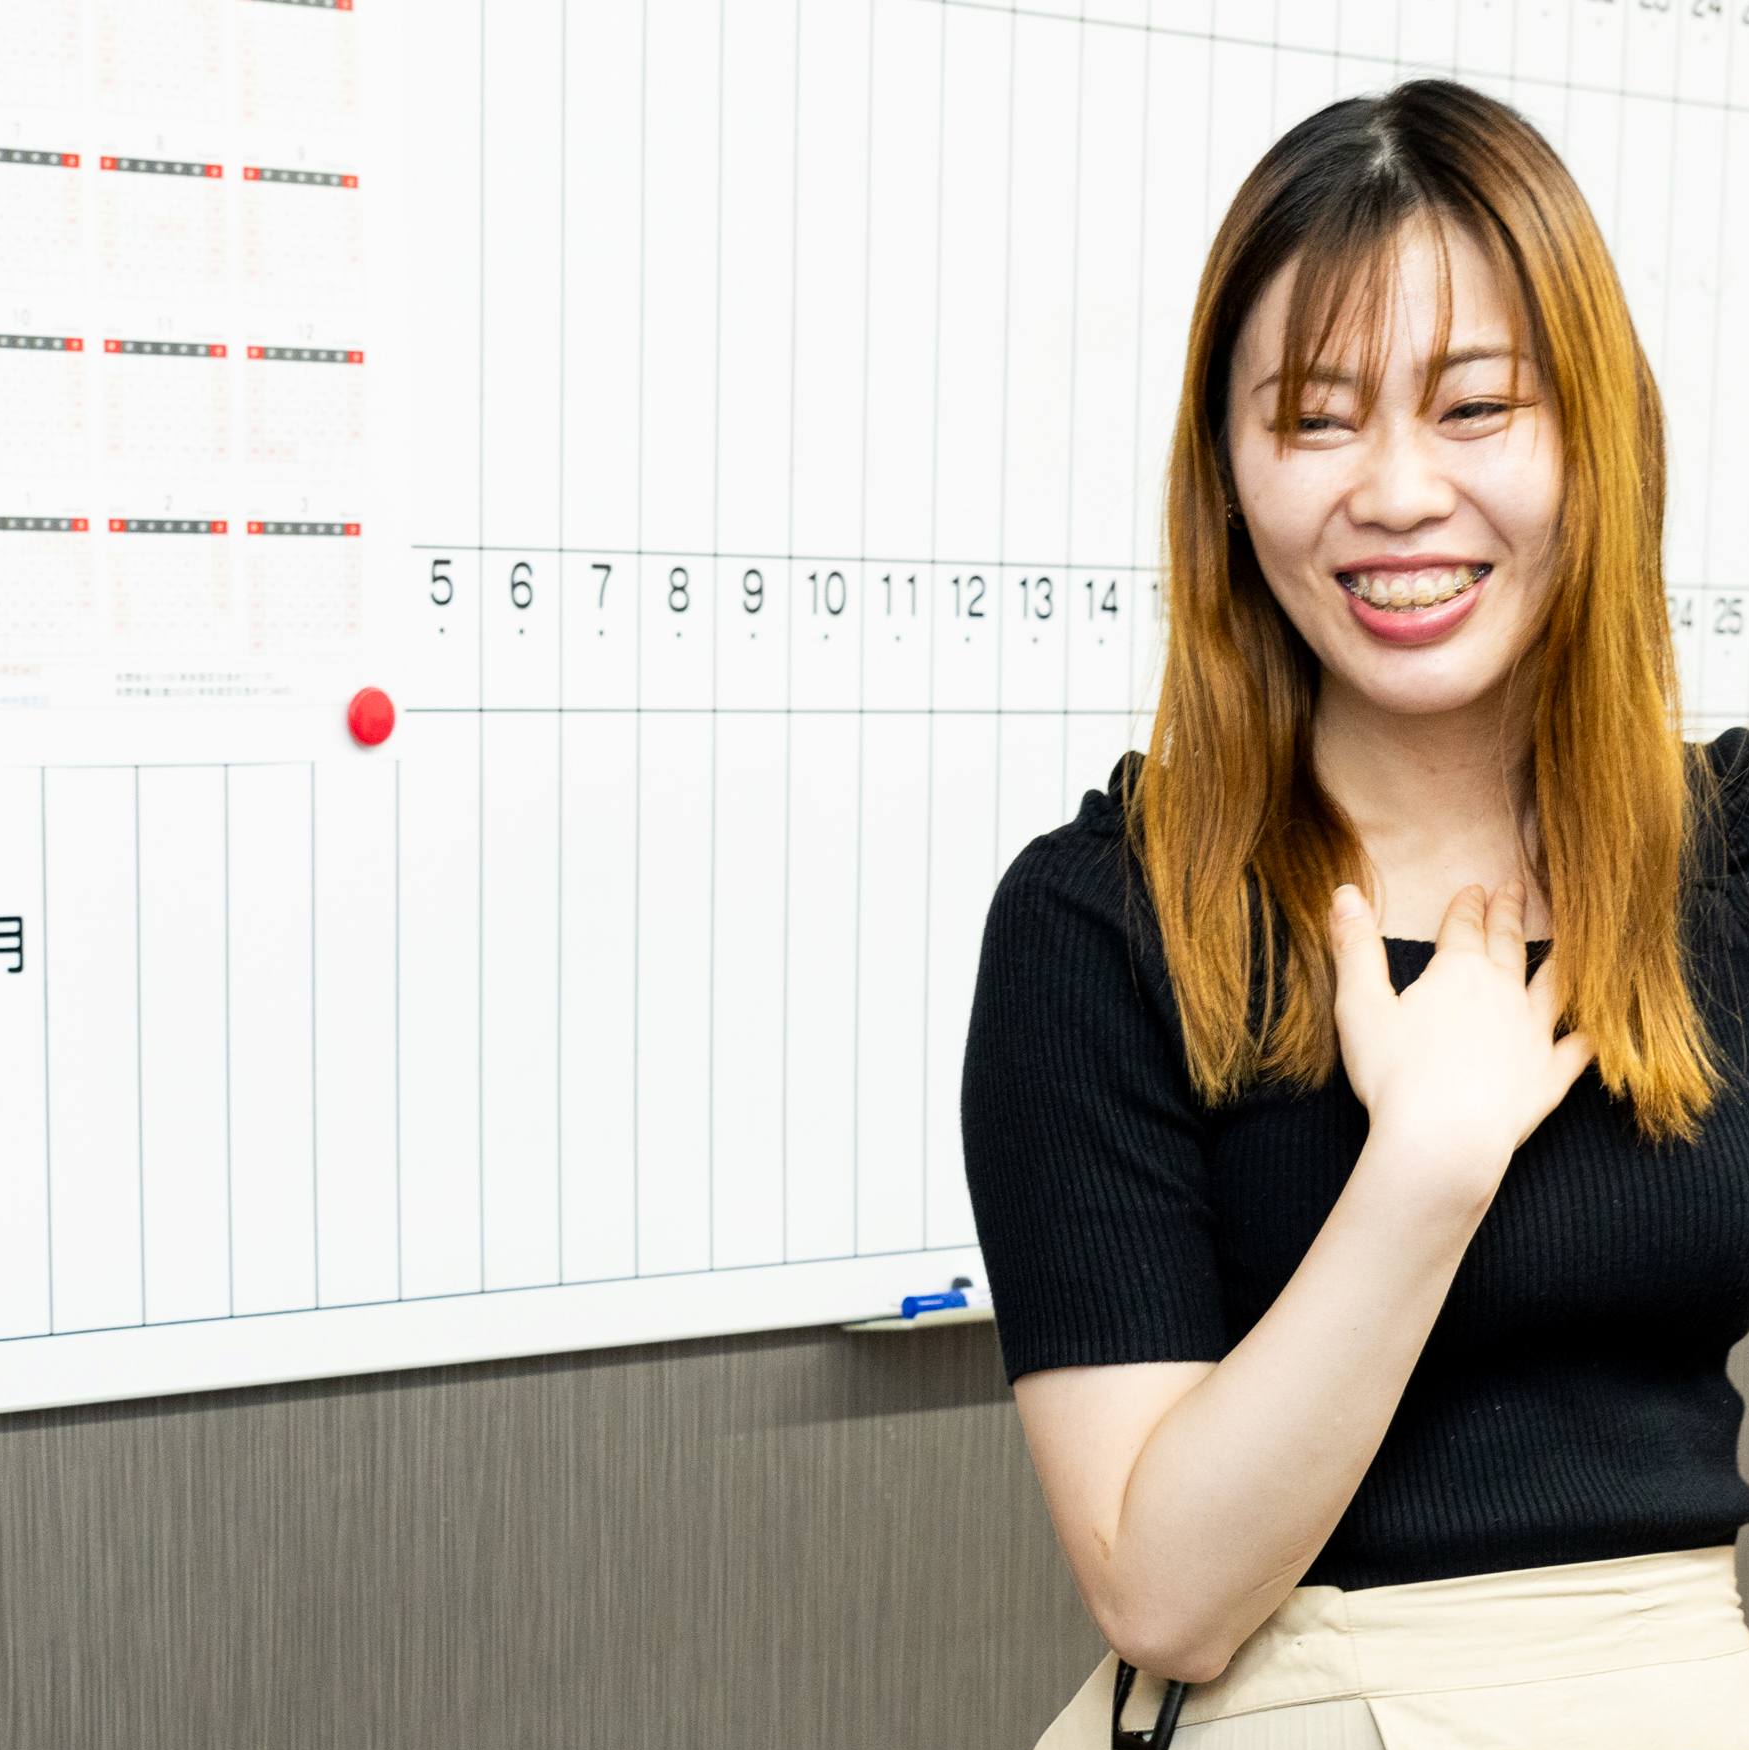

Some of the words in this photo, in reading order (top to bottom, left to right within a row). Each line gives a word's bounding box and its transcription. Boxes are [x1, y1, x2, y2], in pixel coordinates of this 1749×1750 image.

[430, 558, 454, 607] 5
[509, 561, 534, 610] 6
[591, 563, 613, 609] 7
[668, 566, 691, 613] 8
[742, 568, 765, 615] 9
[808, 570, 847, 617] 10
[881, 573, 917, 617] 11
[951, 574, 987, 618] 12
[1019, 576, 1054, 620] 13
[1085, 580, 1119, 620] 14
[1713, 597, 1743, 636] 25
